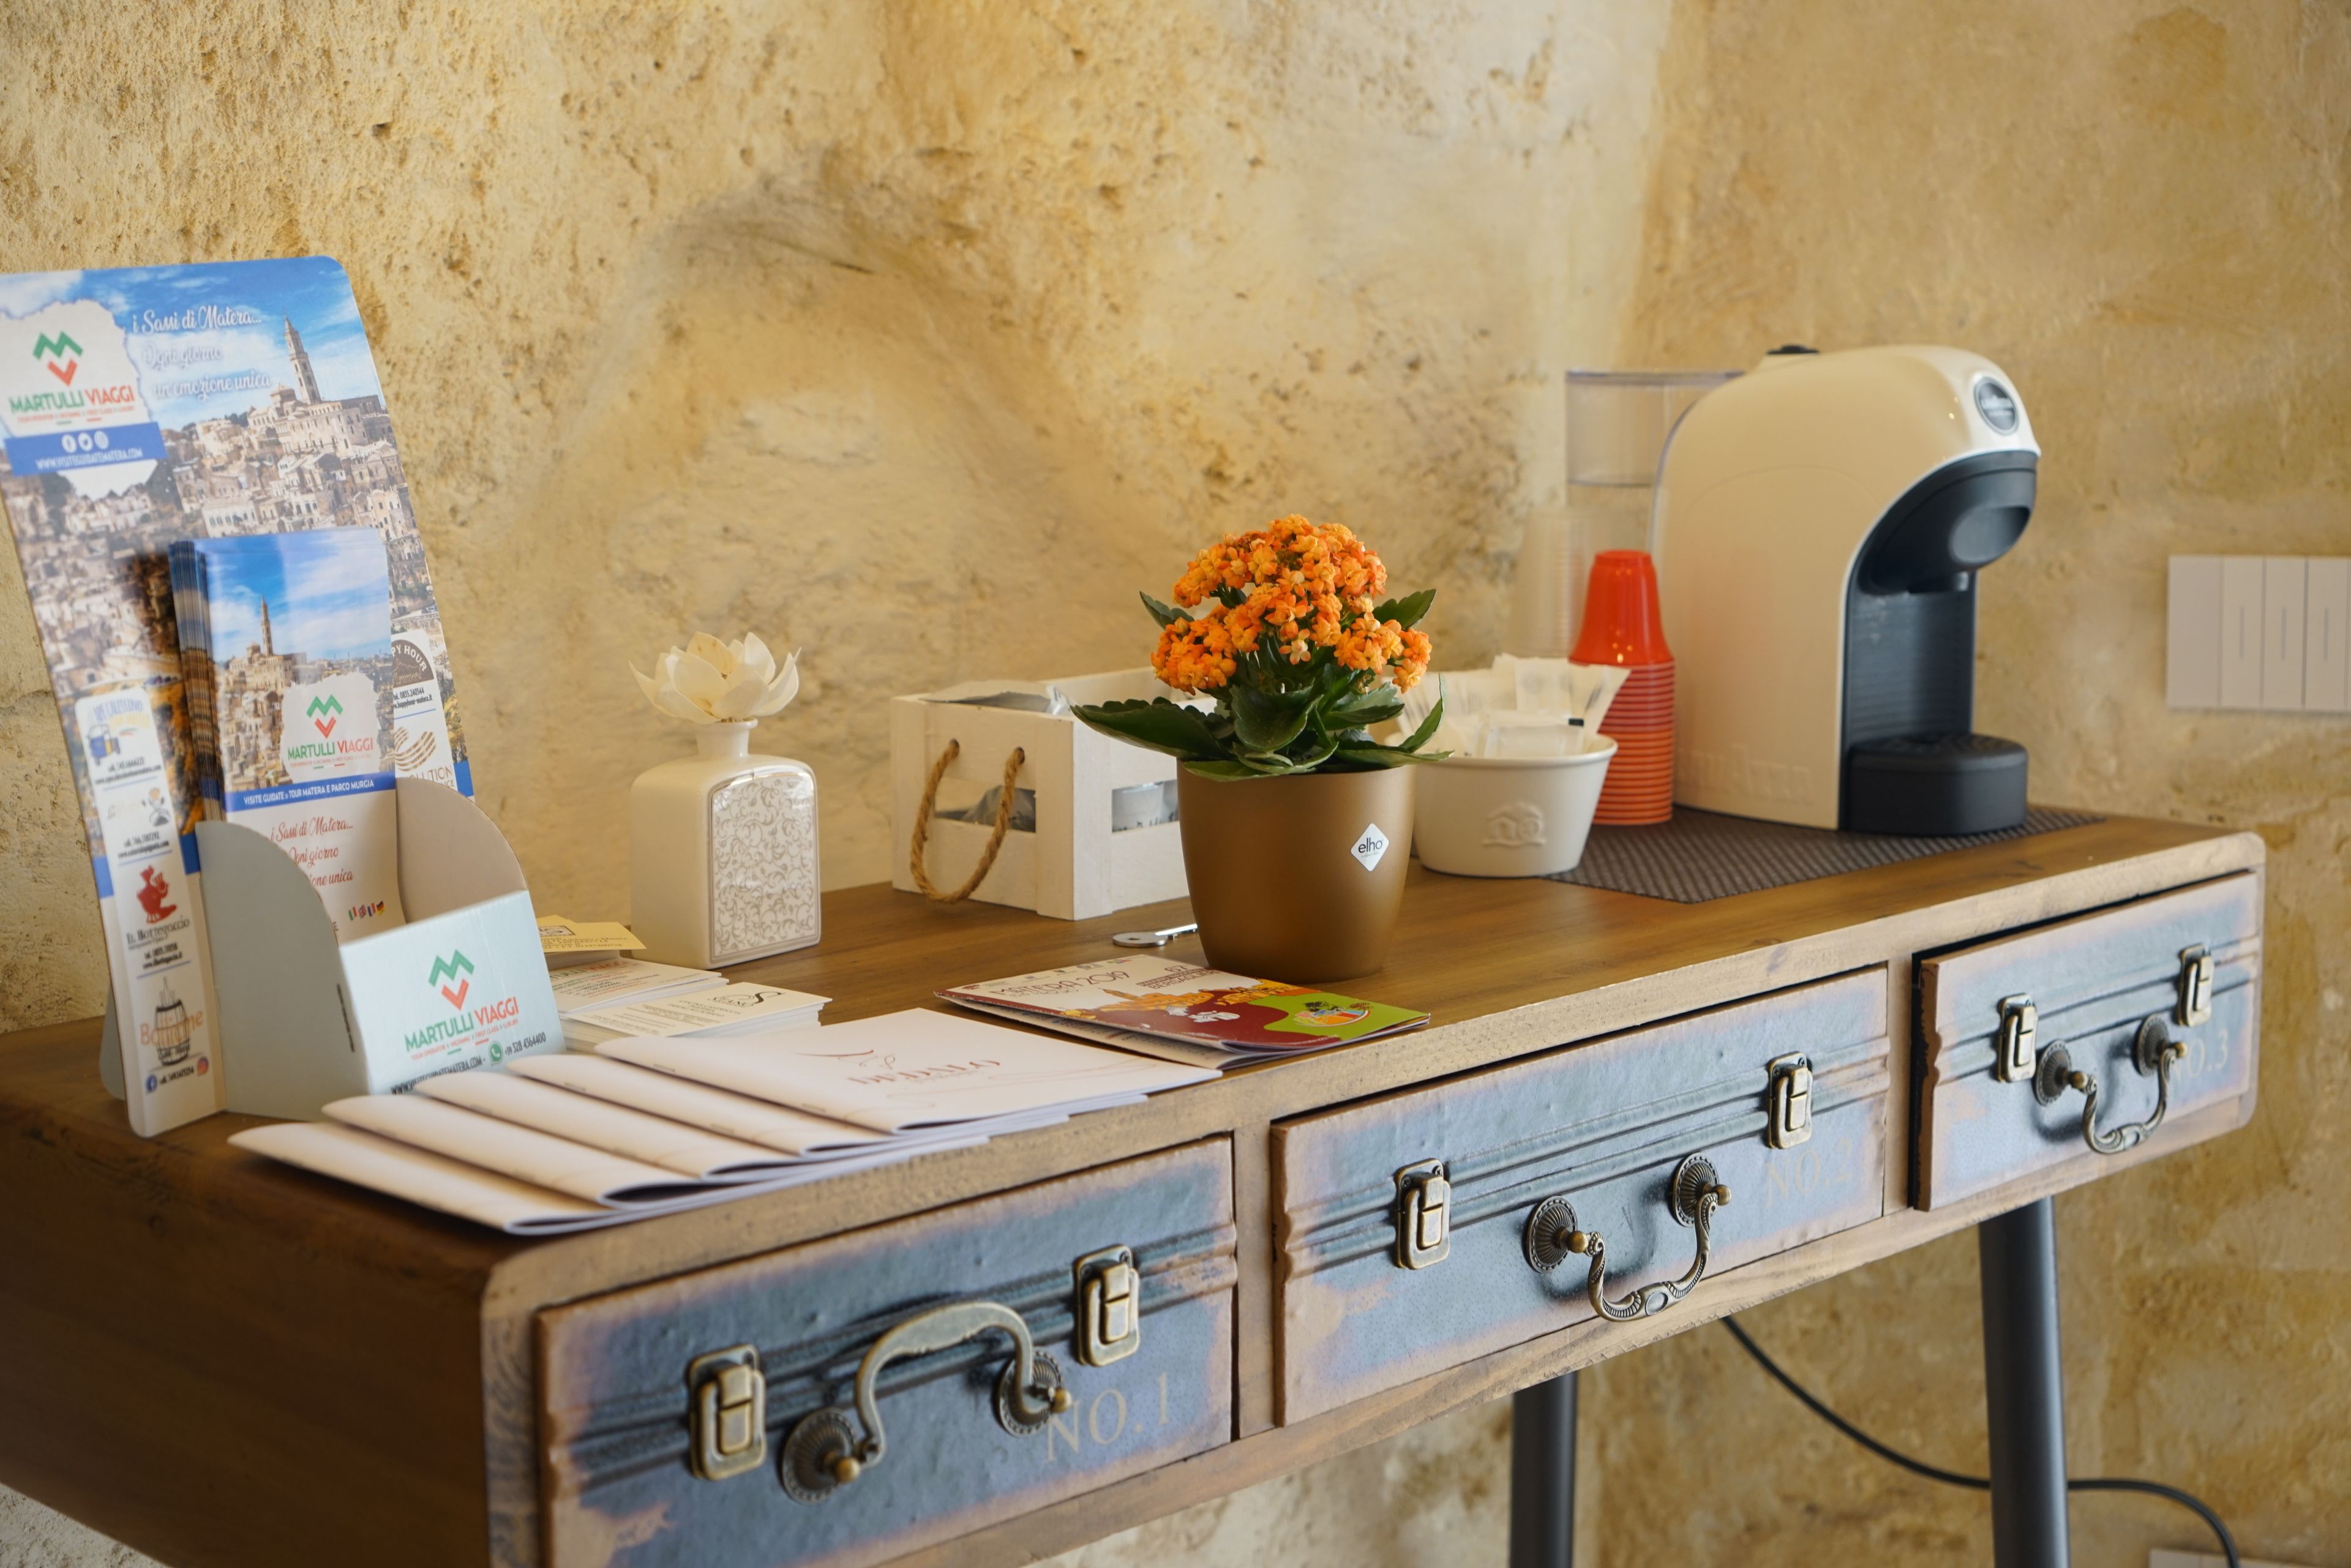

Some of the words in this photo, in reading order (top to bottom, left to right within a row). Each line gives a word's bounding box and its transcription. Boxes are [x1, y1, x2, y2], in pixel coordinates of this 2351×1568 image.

[142, 309, 179, 334] Sassi
[181, 309, 196, 330] di
[173, 375, 233, 402] emozione
[234, 369, 271, 391] unica
[9, 389, 84, 413] MARTULLI
[84, 384, 135, 405] VIAGGI
[403, 645, 427, 672] HOUR
[287, 741, 336, 761] MARTULLI
[337, 737, 374, 755] VIAGGI
[244, 793, 263, 805] VISITE
[263, 790, 285, 803] GUIDATE
[288, 789, 302, 800] TOUR
[302, 786, 326, 797] MATERA
[326, 784, 331, 793] E
[331, 782, 350, 793] PARCO
[351, 778, 375, 790] MURGIA
[276, 821, 298, 843] Sassi
[298, 820, 307, 837] di
[307, 846, 339, 869] giorno
[1358, 837, 1383, 853] elho
[328, 868, 354, 885] unica
[989, 980, 1084, 996] MATERA
[1076, 970, 1131, 986] 2019
[404, 1011, 474, 1052] MARTULLI
[473, 996, 520, 1026] VIAGGI
[512, 1041, 523, 1054] 328
[523, 1032, 547, 1049] 4364400
